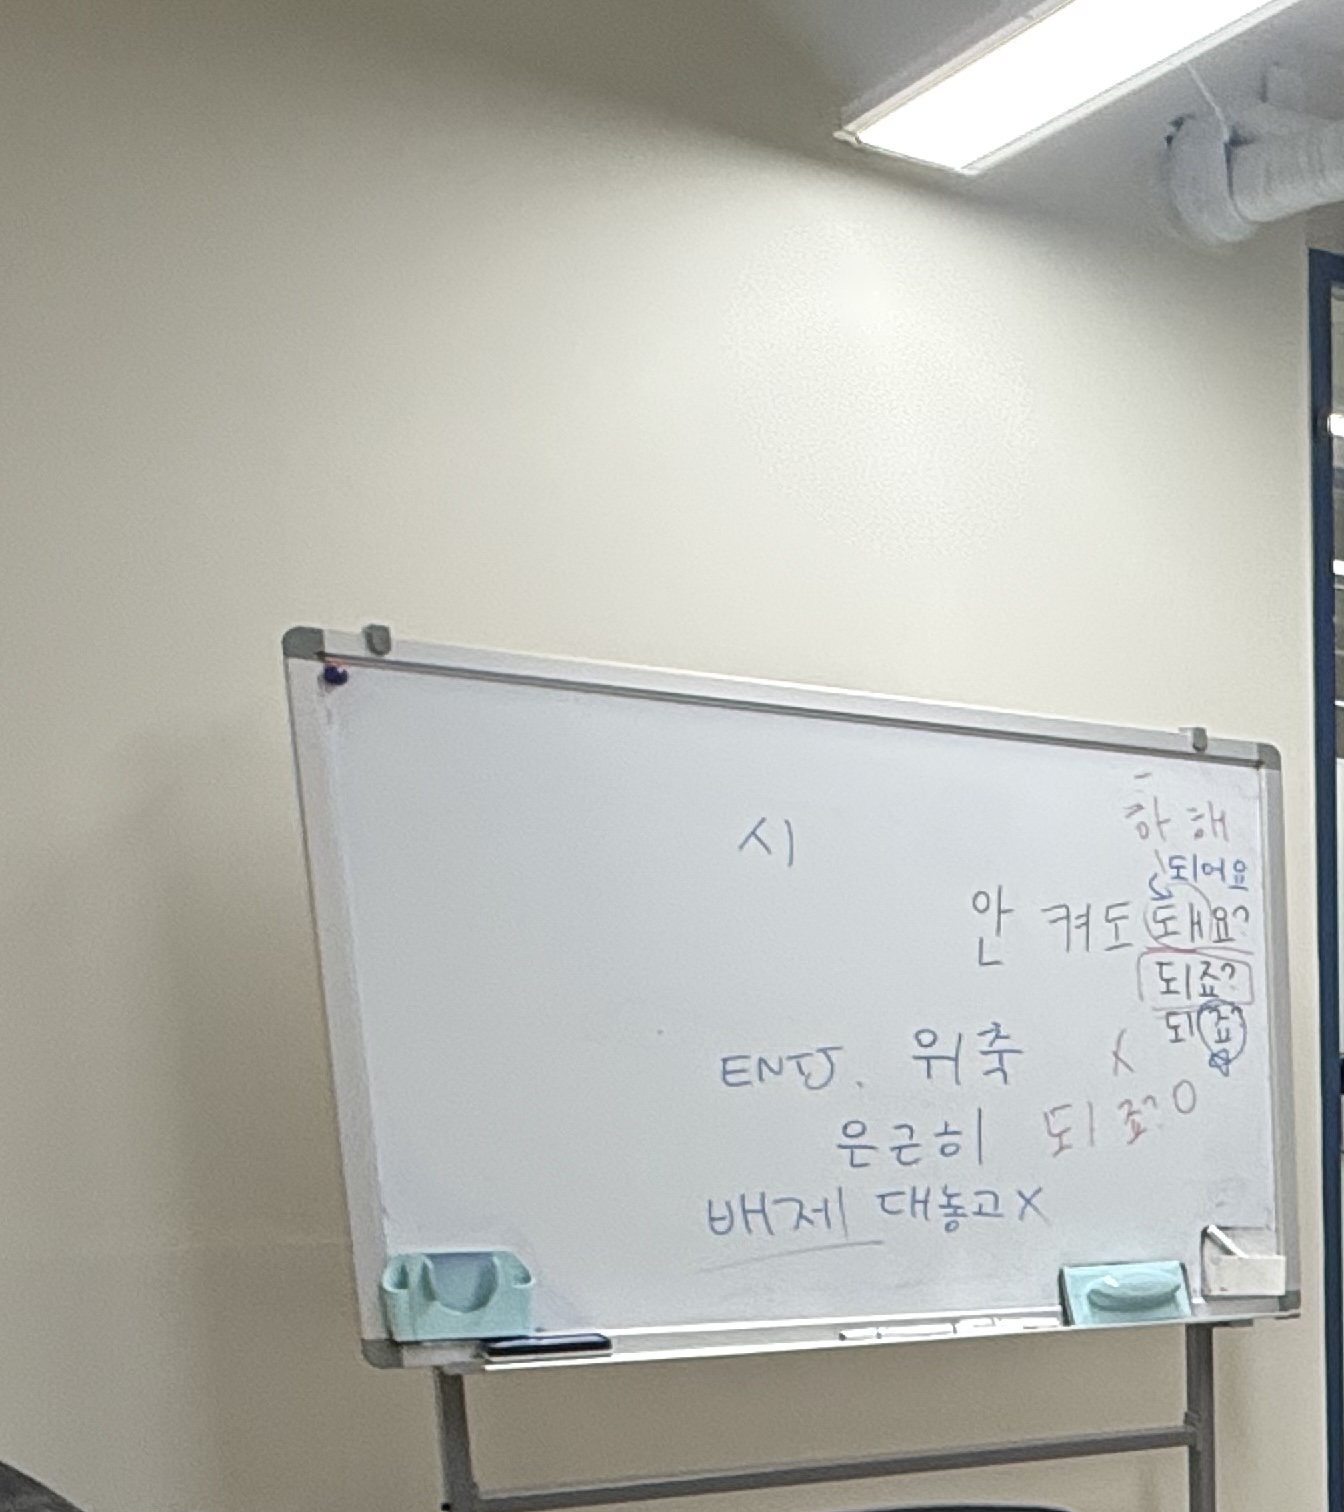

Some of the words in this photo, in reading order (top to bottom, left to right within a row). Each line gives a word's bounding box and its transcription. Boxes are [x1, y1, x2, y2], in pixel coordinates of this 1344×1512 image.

[738, 816, 794, 868] 시
[1167, 853, 1250, 892] 되어요
[972, 885, 1015, 967] 안
[912, 1021, 1024, 1086] 위축
[836, 1106, 984, 1168] 은근히
[707, 1185, 850, 1240] 배제
